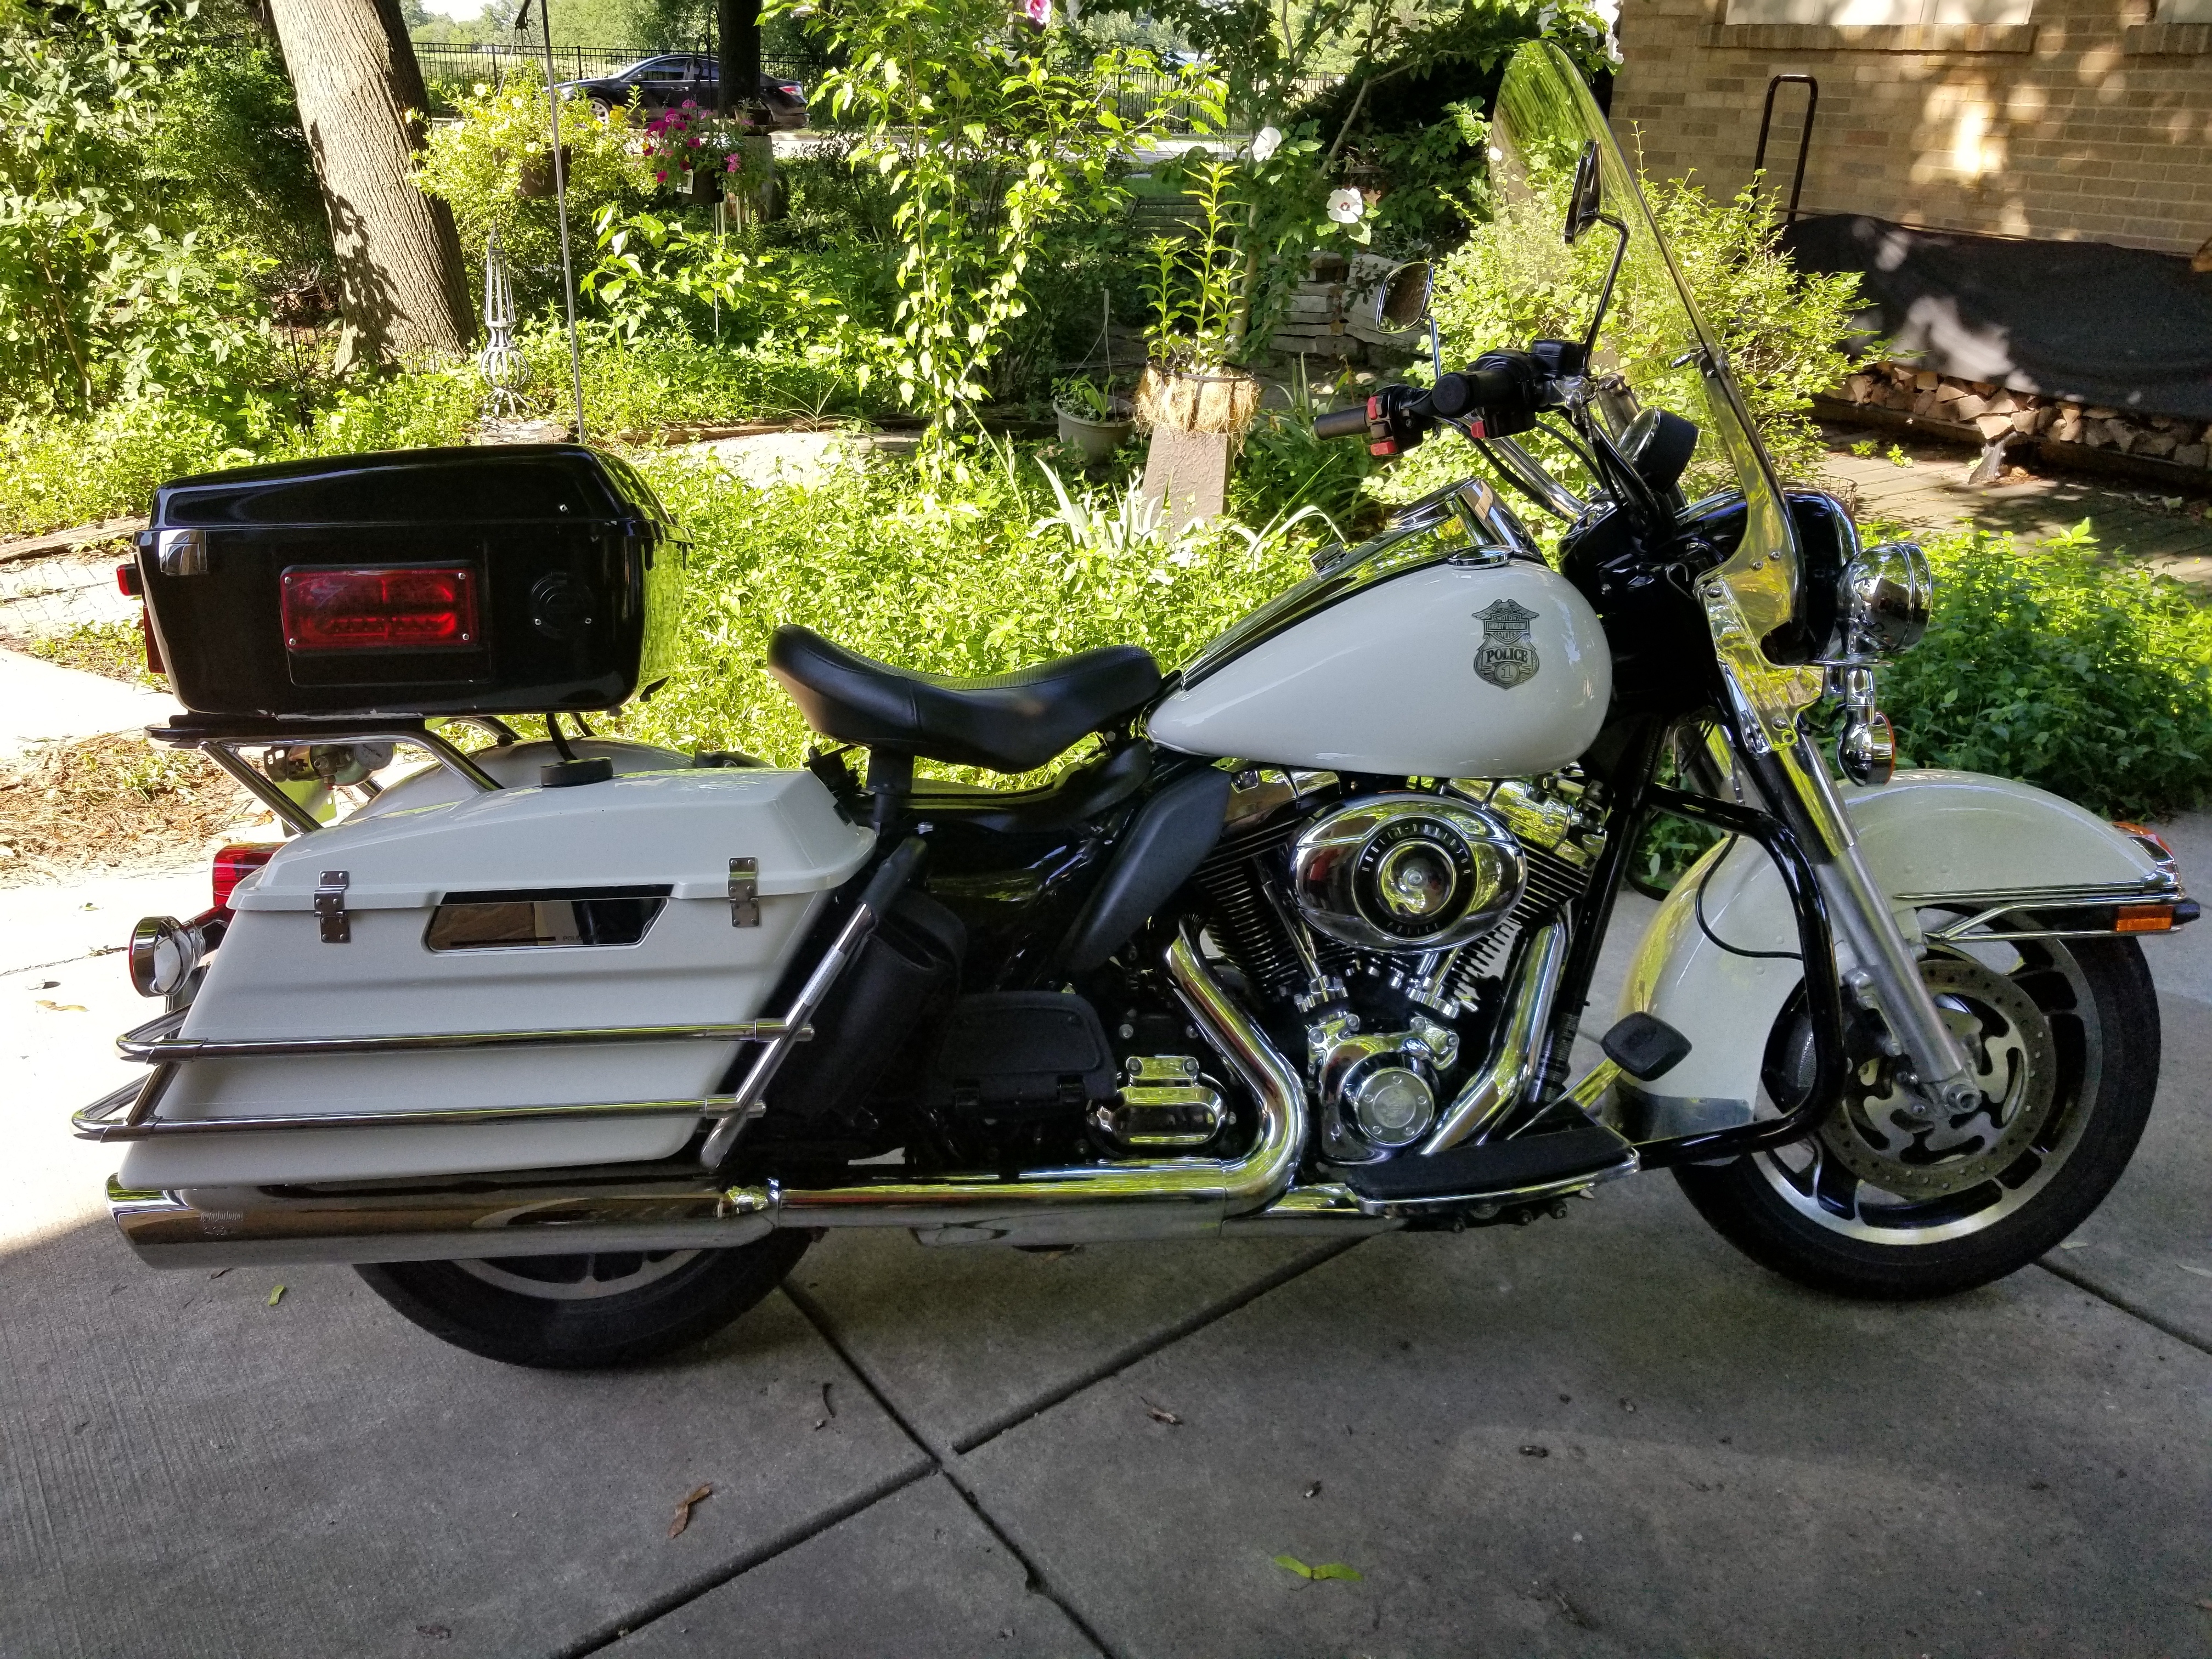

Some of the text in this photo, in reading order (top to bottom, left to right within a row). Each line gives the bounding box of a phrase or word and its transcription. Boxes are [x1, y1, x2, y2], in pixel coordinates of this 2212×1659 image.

[1486, 647, 1528, 663] POLICE
[1501, 665, 1513, 679] 1
[1361, 823, 1471, 876] HARLEY-DAVIDSON
